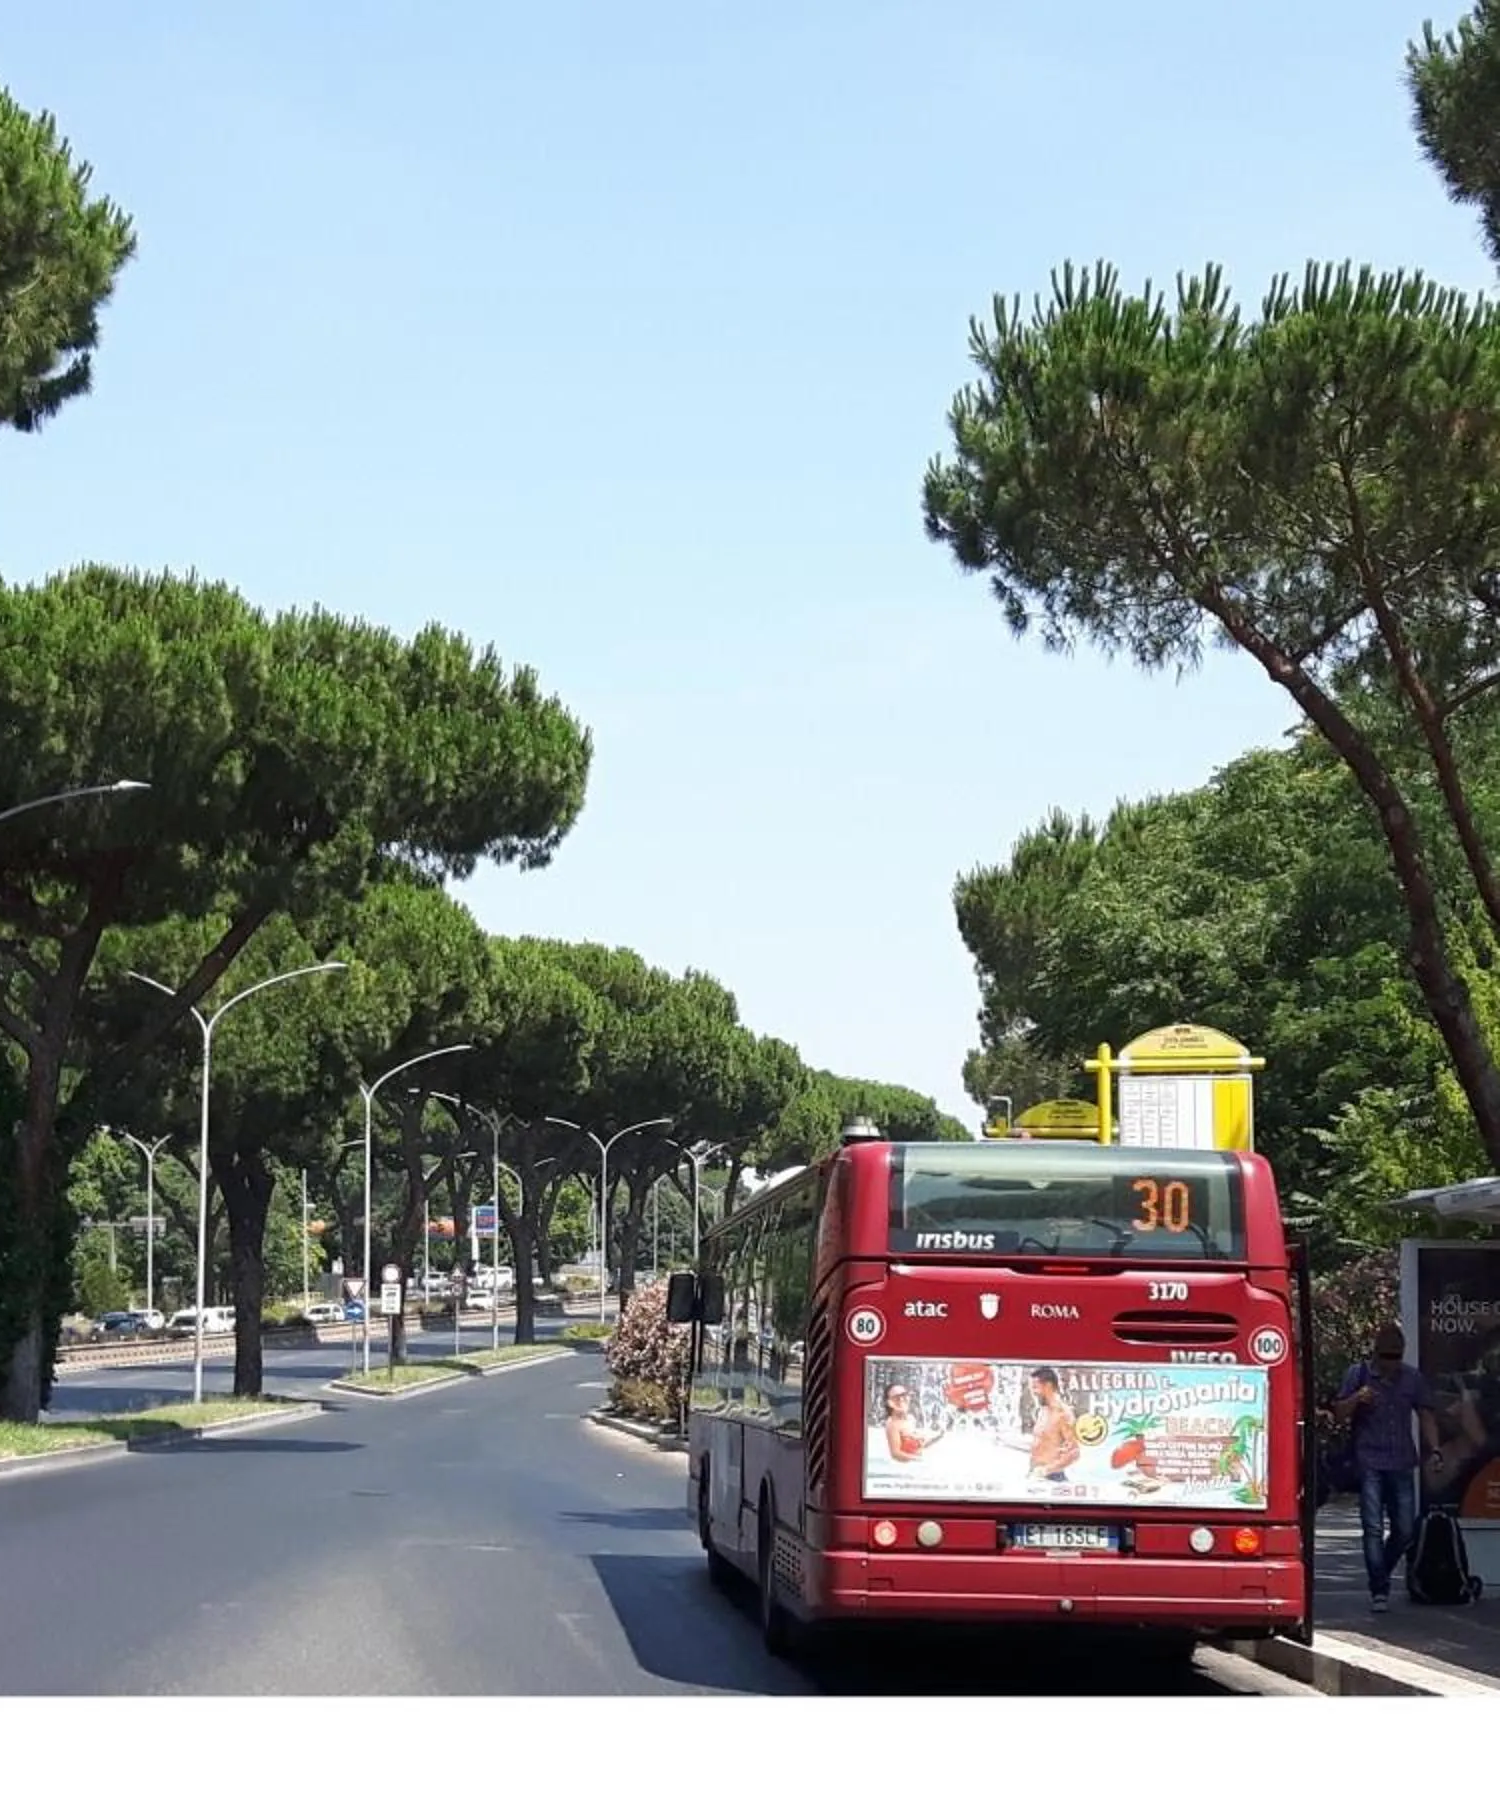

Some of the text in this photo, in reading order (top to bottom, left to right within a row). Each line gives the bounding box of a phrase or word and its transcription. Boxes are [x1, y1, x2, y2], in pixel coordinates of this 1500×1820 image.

[1132, 1178, 1190, 1233] 30
[916, 1231, 995, 1250] irisbus
[1148, 1282, 1188, 1300] 3170
[903, 1300, 948, 1317] atac
[1030, 1303, 1080, 1319] ROMA
[1431, 1299, 1490, 1315] HOUSE
[856, 1317, 875, 1334] 80
[1431, 1318, 1478, 1333] NOW.
[1257, 1338, 1281, 1353] 100
[1171, 1350, 1237, 1364] IVECO
[1068, 1371, 1157, 1392] ALLEGRIA
[1088, 1376, 1257, 1422] Hydromania
